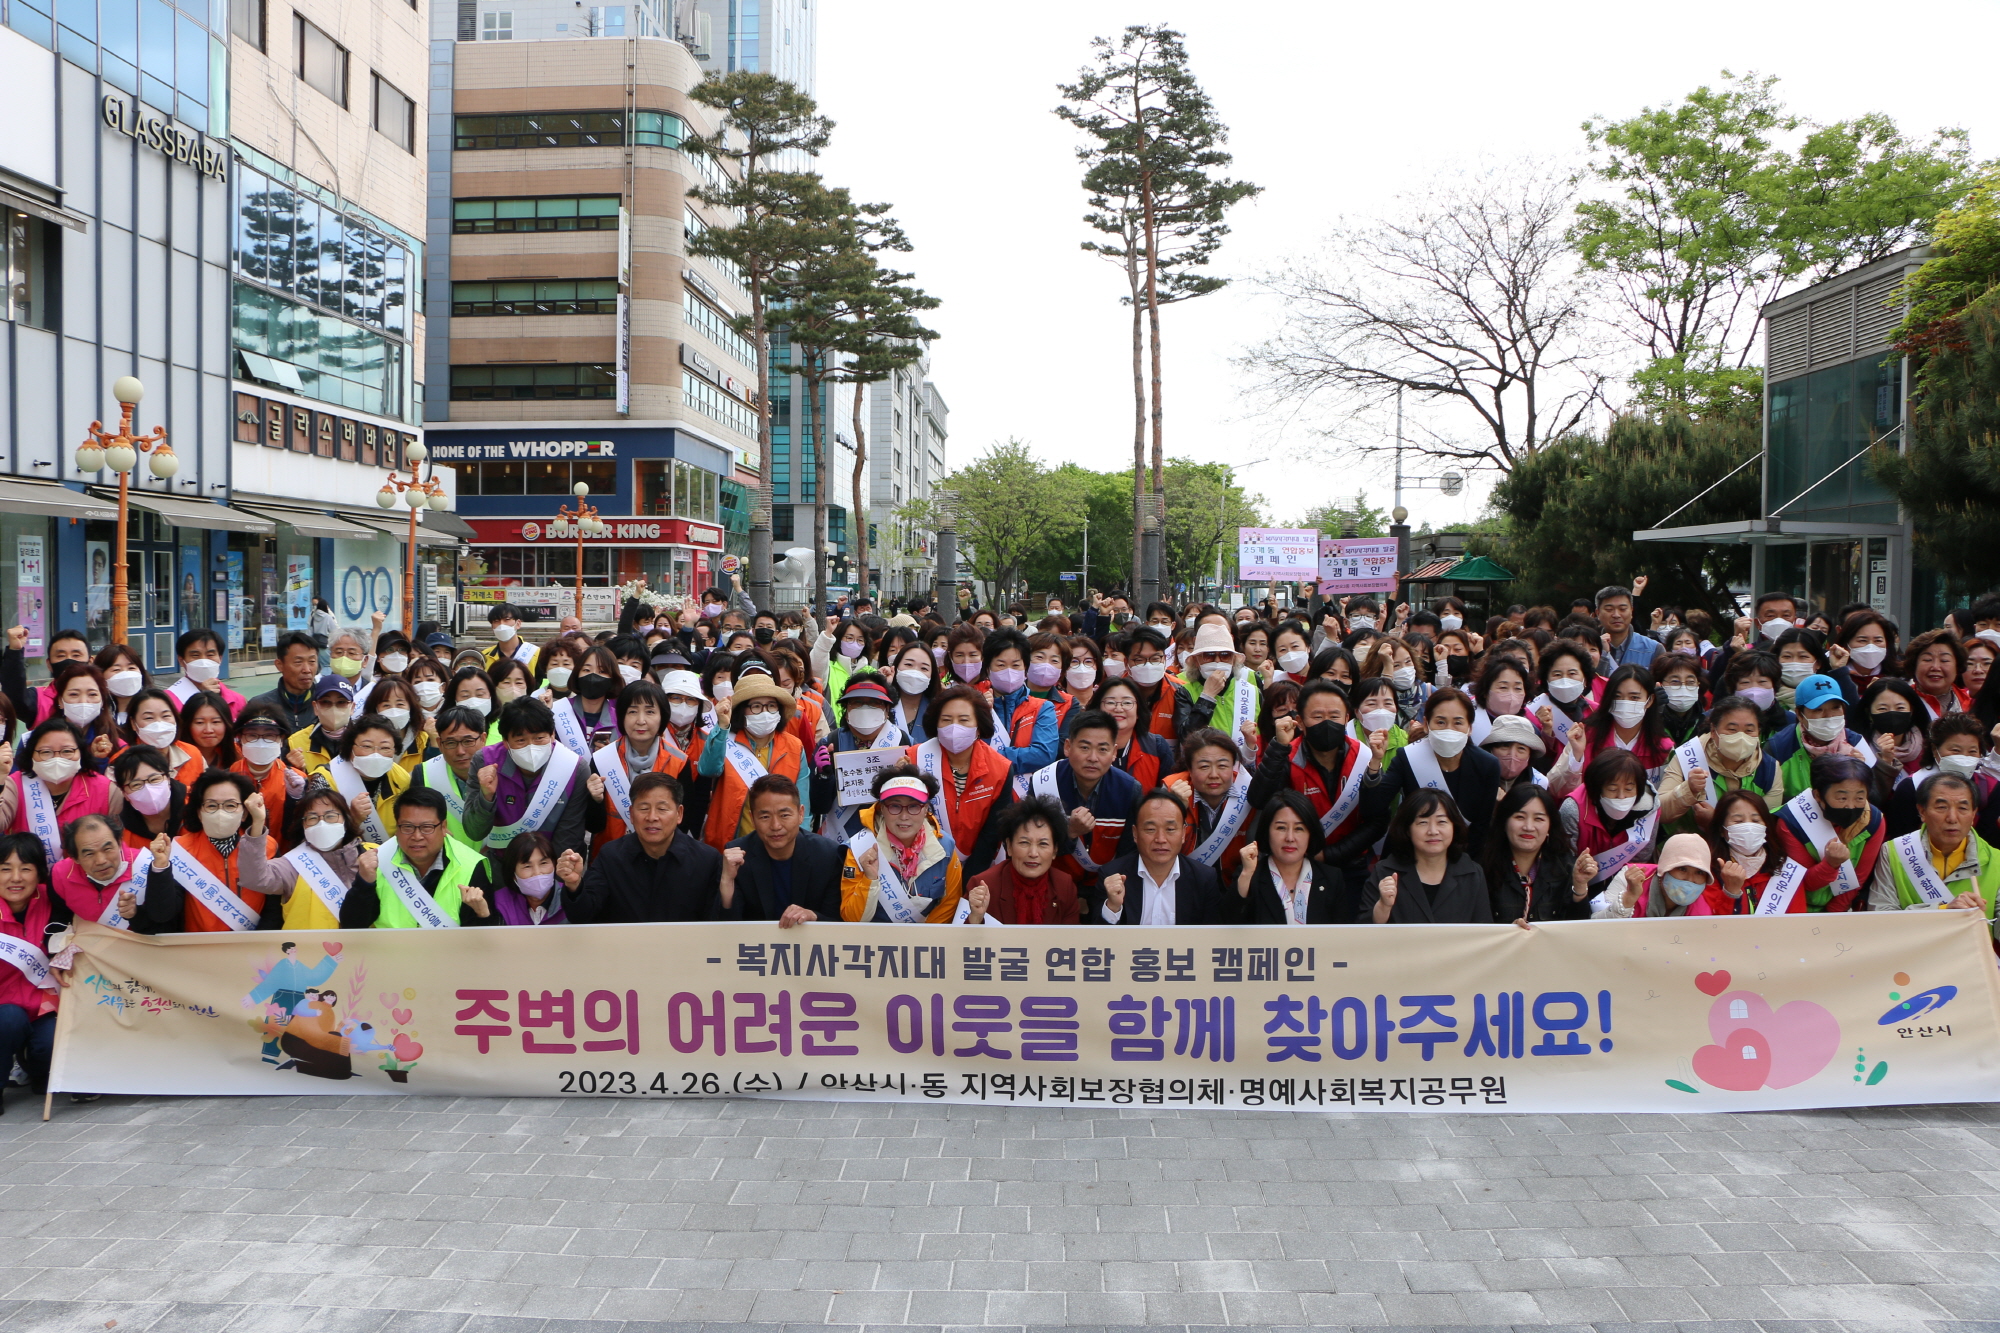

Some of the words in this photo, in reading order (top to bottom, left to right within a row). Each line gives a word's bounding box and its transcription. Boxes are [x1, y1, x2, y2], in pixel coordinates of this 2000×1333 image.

[102, 94, 227, 183] GLASSBABA
[432, 445, 464, 458] HOME
[467, 445, 482, 458] OF
[484, 445, 505, 458] THE
[617, 524, 660, 539] KING
[21, 558, 40, 574] 1+1
[558, 711, 575, 736] 안산시
[843, 767, 863, 777] 호수동
[866, 755, 880, 764] 3조
[538, 779, 559, 809] 안산시
[607, 768, 626, 796] 안산시
[844, 779, 865, 787] 초지동
[29, 781, 44, 810] 안산시
[34, 813, 53, 836] 동(洞)
[171, 855, 198, 880] 안산시
[298, 852, 323, 878] 안산시
[1776, 862, 1798, 893] 어려운
[1904, 845, 1926, 879] 이웃을
[1920, 877, 1942, 900] 함께
[391, 867, 415, 899] 어려운
[413, 897, 442, 928] 이웃을
[737, 943, 946, 980] 복지사각지대
[962, 946, 1030, 982] 발굴
[1045, 946, 1115, 983] 연합
[1129, 947, 1197, 984] 홍보
[1211, 946, 1316, 984] 캠페인
[188, 1004, 220, 1019] 안산
[454, 988, 640, 1056] 주변의
[667, 989, 859, 1058] 어려운
[886, 992, 1080, 1061] 이웃을
[1107, 994, 1235, 1063] 함께
[1263, 989, 1614, 1063] 찾아주세요!
[1896, 1023, 1952, 1039] 안산시
[558, 1070, 782, 1095] 2023.4.26.(수)
